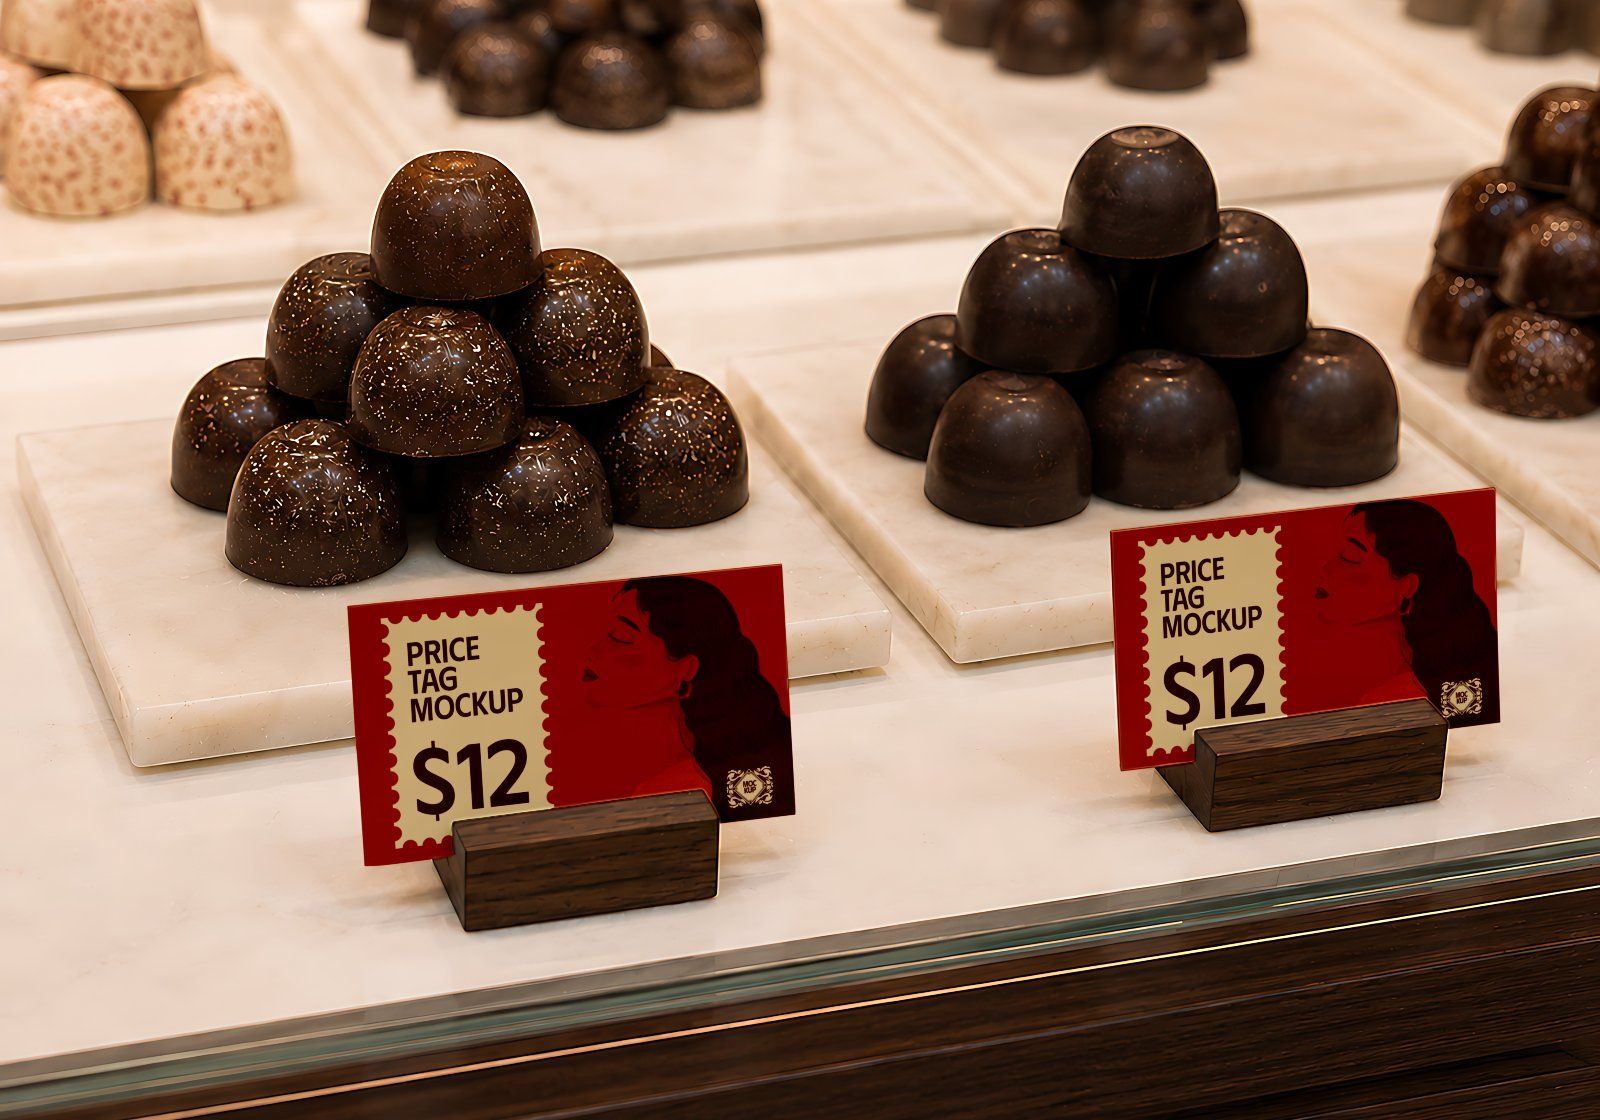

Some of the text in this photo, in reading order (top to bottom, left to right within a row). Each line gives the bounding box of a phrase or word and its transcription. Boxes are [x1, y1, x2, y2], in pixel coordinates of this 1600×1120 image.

[1160, 556, 1225, 586] PRICE
[1160, 585, 1205, 613] TAG
[1162, 605, 1263, 639] MOCKUP
[406, 635, 480, 666] PRICE
[408, 666, 458, 695] TAG
[1163, 653, 1266, 731] $12
[410, 687, 524, 723] MOCKUP
[412, 738, 530, 821] $12
